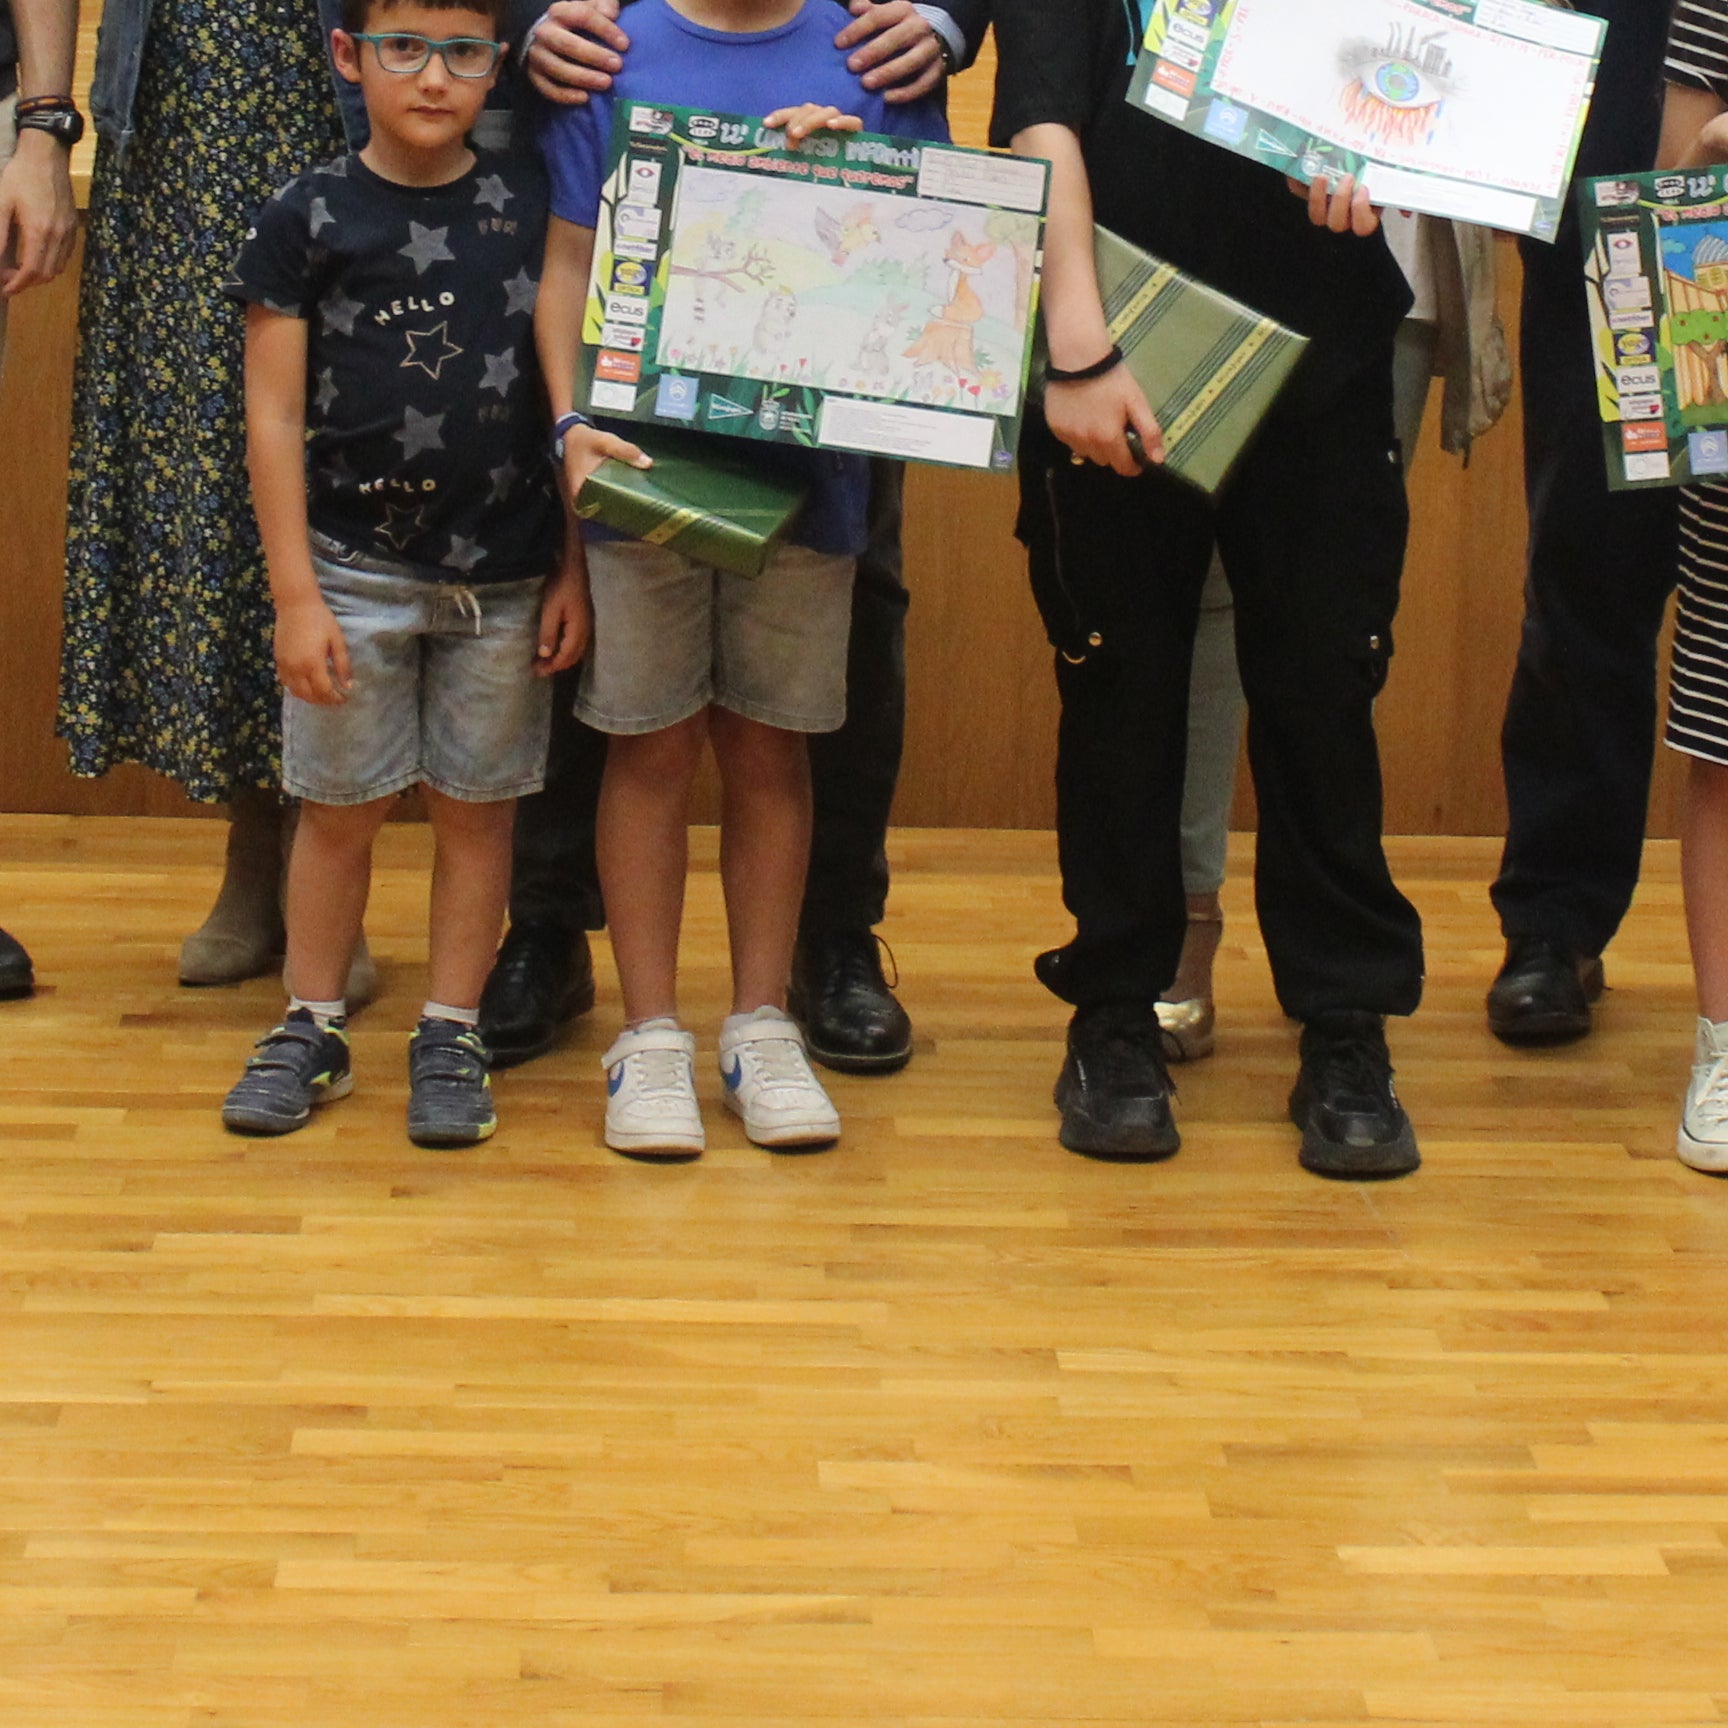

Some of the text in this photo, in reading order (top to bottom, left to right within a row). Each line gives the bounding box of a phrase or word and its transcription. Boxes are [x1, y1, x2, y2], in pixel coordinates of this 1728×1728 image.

[373, 291, 455, 326] HELLO
[609, 301, 645, 317] ecus
[1620, 374, 1657, 386] ecus
